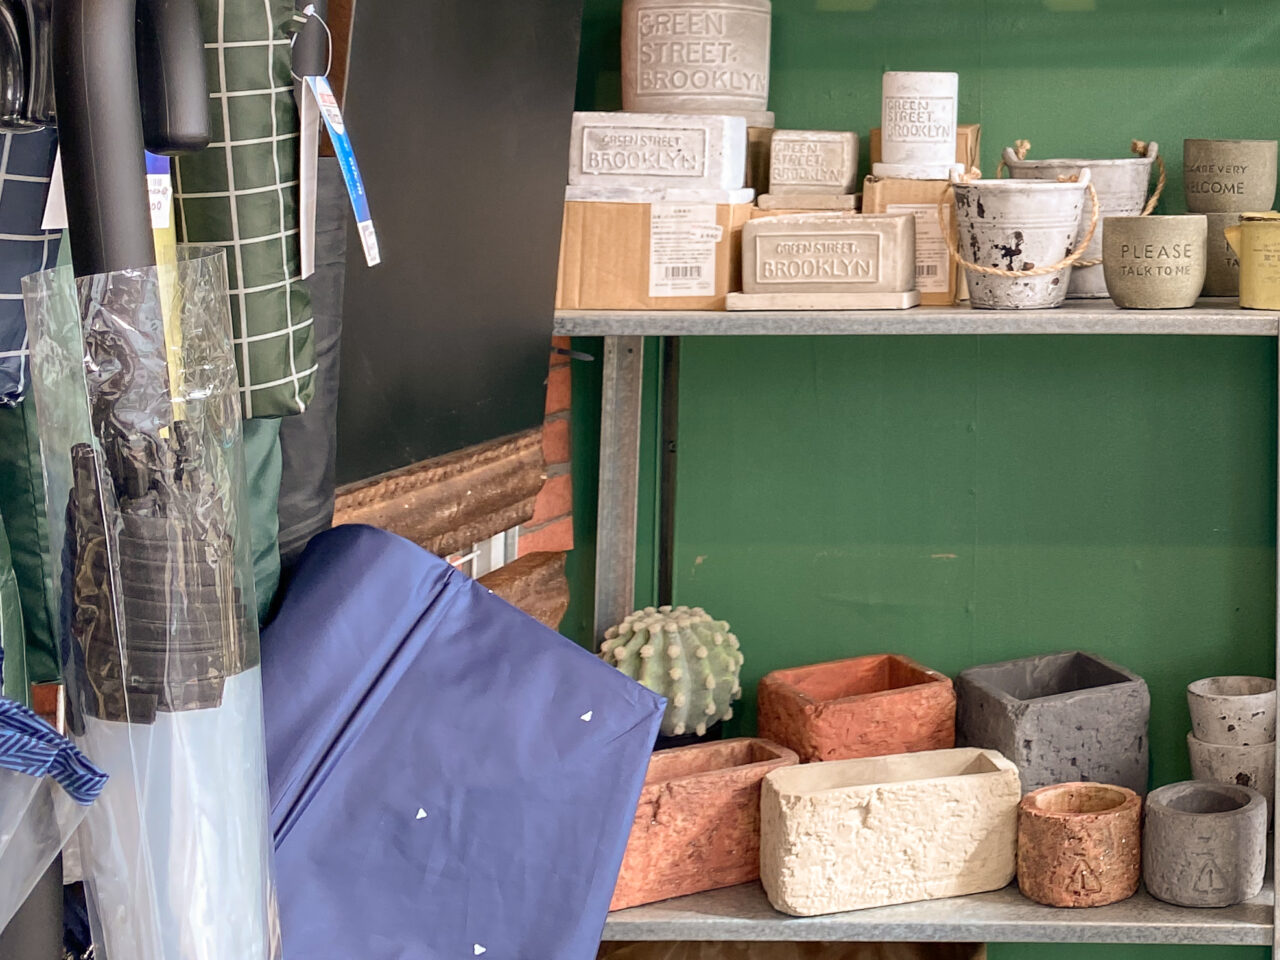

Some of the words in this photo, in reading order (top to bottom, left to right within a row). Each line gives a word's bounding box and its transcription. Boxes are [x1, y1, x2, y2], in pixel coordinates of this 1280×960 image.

[639, 12, 724, 38] GREEN
[640, 70, 766, 92] BROOKLYN
[887, 100, 929, 111] GREEN
[887, 123, 951, 139] BROOKLYN
[601, 134, 639, 147] GREEN
[773, 142, 818, 154] GREEN
[588, 151, 697, 171] BROOKLYN
[1217, 164, 1248, 174] VERY
[772, 166, 841, 182] BROOKLYN
[775, 241, 812, 254] GREEN
[1121, 243, 1192, 259] PLEASE
[763, 258, 873, 278] BROOKLYN
[1120, 265, 1152, 276] TALK
[1157, 265, 1172, 276] TO
[1175, 265, 1192, 276] ME
